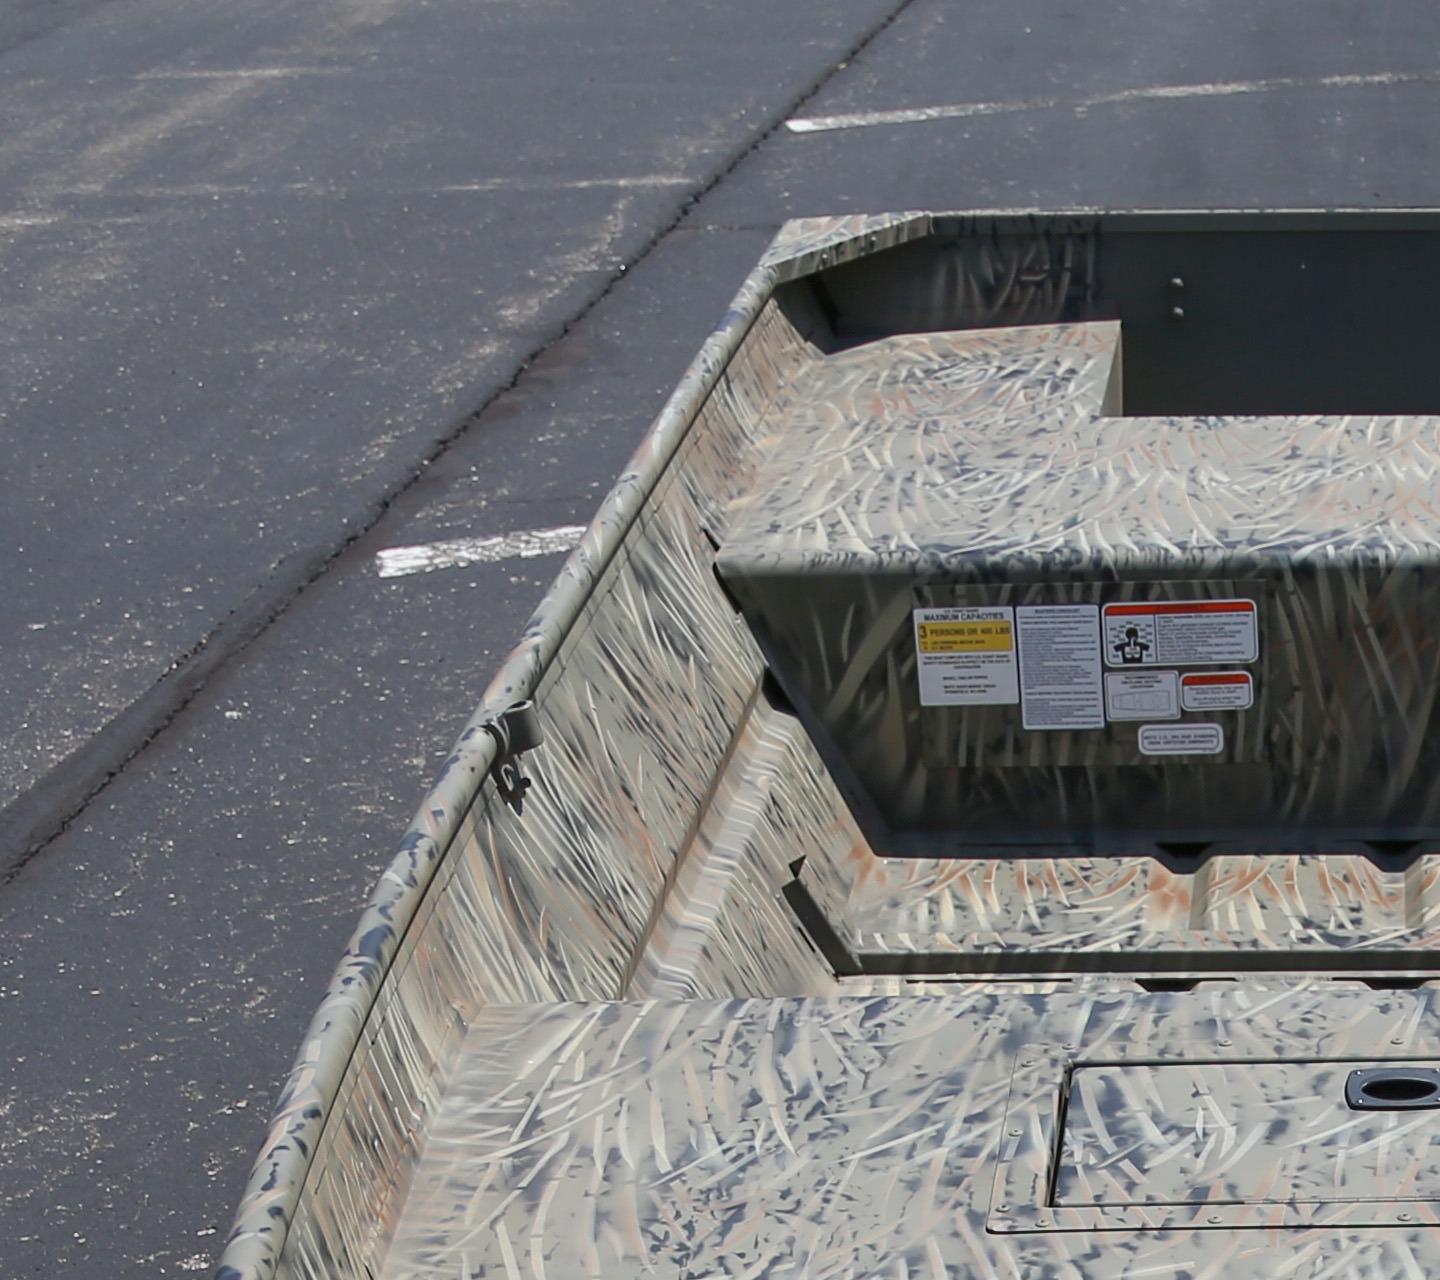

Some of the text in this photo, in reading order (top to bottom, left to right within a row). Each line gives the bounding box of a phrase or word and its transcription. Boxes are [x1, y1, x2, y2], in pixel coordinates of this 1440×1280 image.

[924, 612, 1004, 621] MAXIMUM CAPACITIES
[920, 626, 927, 638] 3
